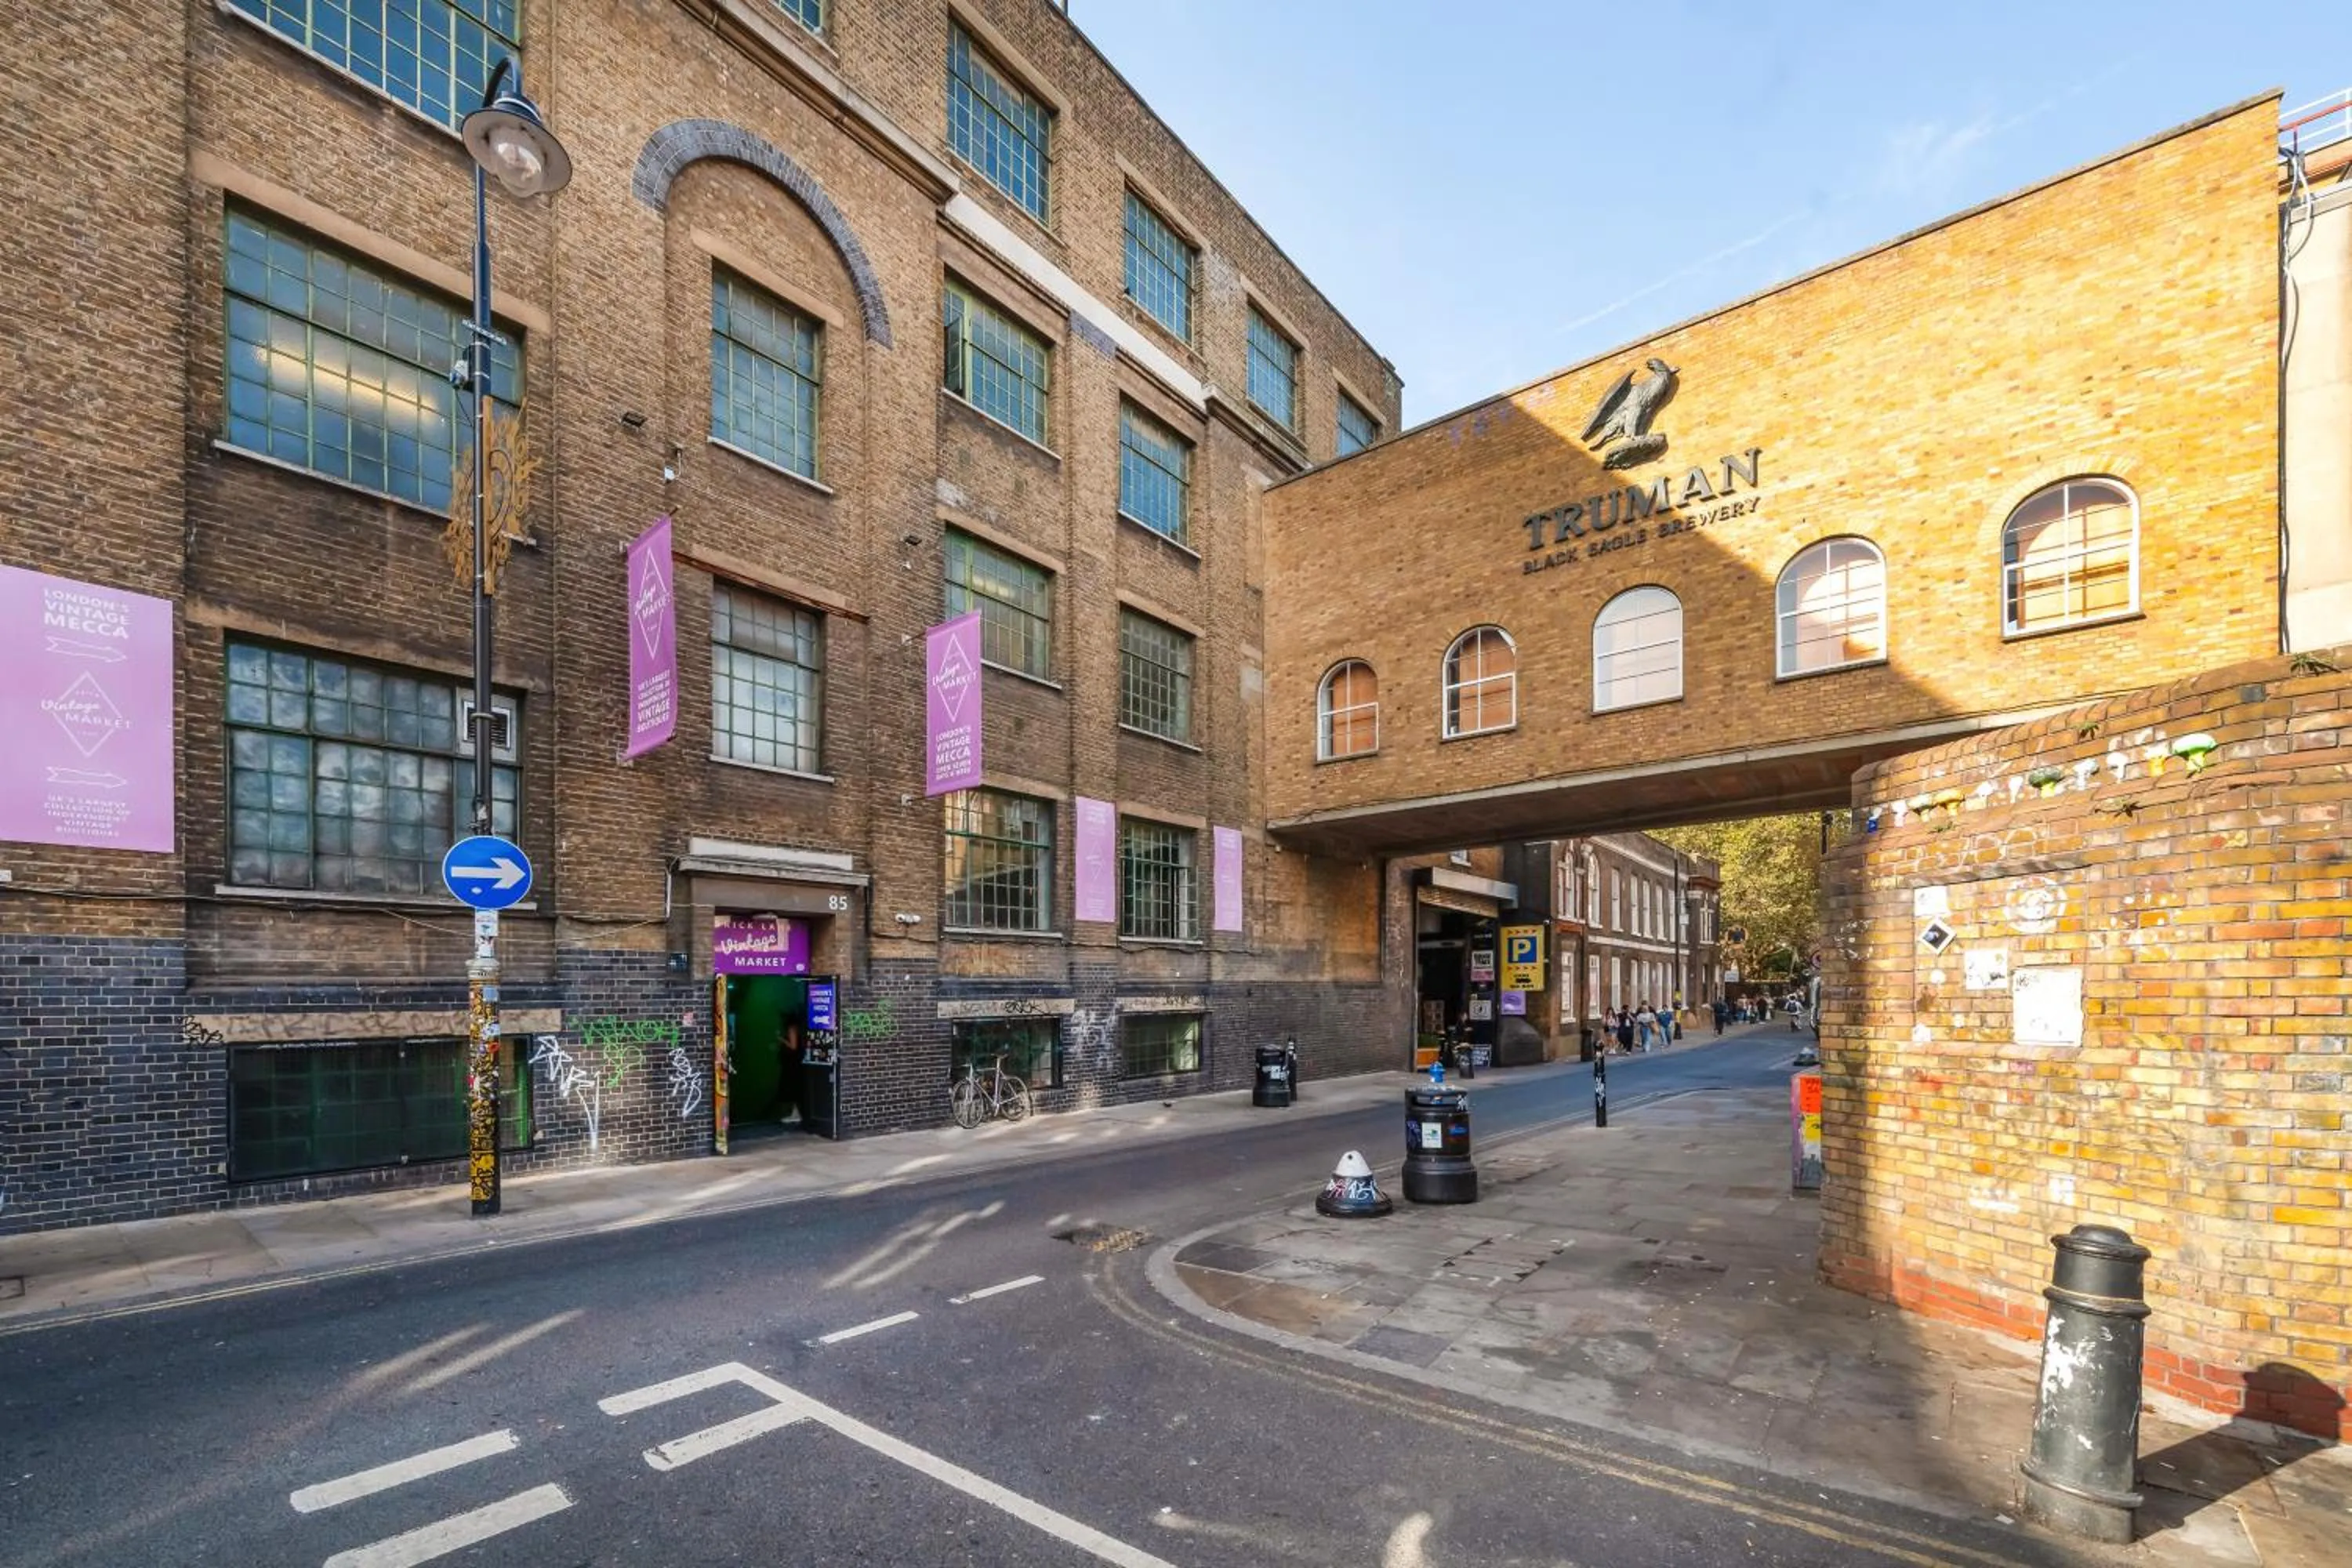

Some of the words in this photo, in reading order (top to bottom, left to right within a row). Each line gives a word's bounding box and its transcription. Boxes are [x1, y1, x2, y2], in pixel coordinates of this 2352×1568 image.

[1523, 448, 1762, 551] TRUMAN
[1523, 550, 1578, 575] BLACK
[1588, 529, 1647, 557] EAGLE
[1658, 496, 1761, 538] BREWERY
[43, 587, 129, 613] LONDON'S
[45, 599, 132, 625] VINTAGE
[44, 612, 129, 639] MECCA
[943, 670, 978, 689] MARKET
[41, 699, 100, 714] Vintage
[637, 699, 670, 722] VINTAGE
[65, 713, 132, 728] MARKET
[935, 725, 971, 742] LONDON'S
[936, 735, 971, 752] VINTAGE
[936, 746, 971, 765] MECCA
[828, 895, 848, 911] 85
[720, 933, 777, 955] Vintage
[1513, 939, 1531, 961] P
[734, 956, 787, 967] MARKET
